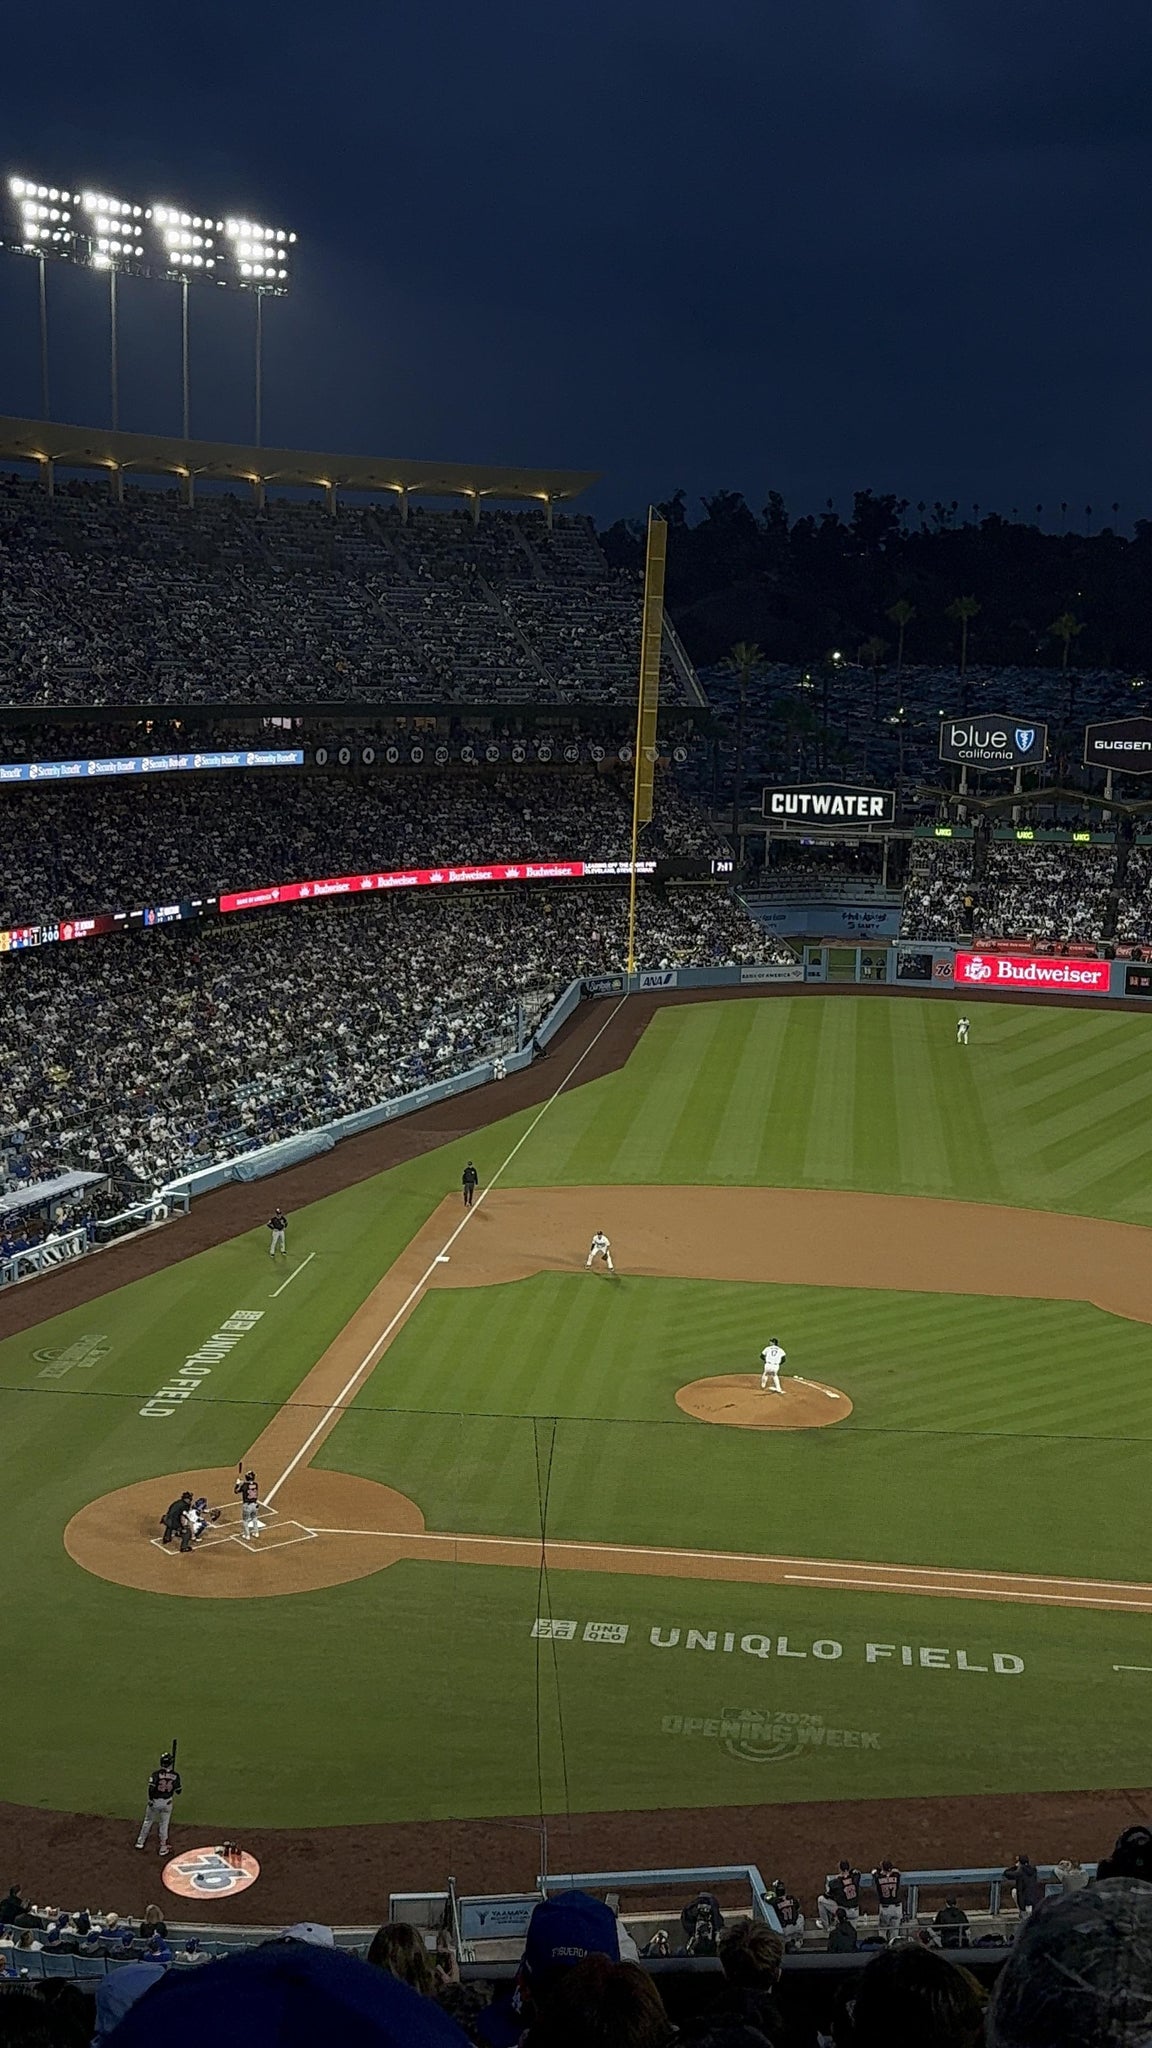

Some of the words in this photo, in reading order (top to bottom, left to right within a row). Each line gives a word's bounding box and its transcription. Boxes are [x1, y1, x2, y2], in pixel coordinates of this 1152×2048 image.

[951, 725, 1008, 748] blue
[959, 749, 1014, 760] california
[771, 793, 884, 816] CUTWATER
[936, 828, 952, 836] UKG
[1017, 831, 1034, 839] UKG
[1073, 833, 1090, 841] UKG
[526, 867, 572, 877] Budweiser
[716, 862, 732, 872] 7:11
[377, 876, 418, 887] Budweiser
[448, 871, 492, 882] Budweiser
[314, 884, 350, 896] Budweiser
[935, 963, 952, 976] 76
[997, 961, 1102, 984] Budweiser
[642, 975, 663, 986] ANA
[178, 1333, 244, 1376] UNIQLO
[138, 1378, 202, 1418] FIELD
[592, 1624, 621, 1632] UNI
[588, 1632, 621, 1640] QLO
[648, 1626, 843, 1660] UNIQLO
[866, 1642, 1025, 1676] FIELD
[661, 1714, 792, 1743] OPENING
[797, 1726, 882, 1750] WEEK
